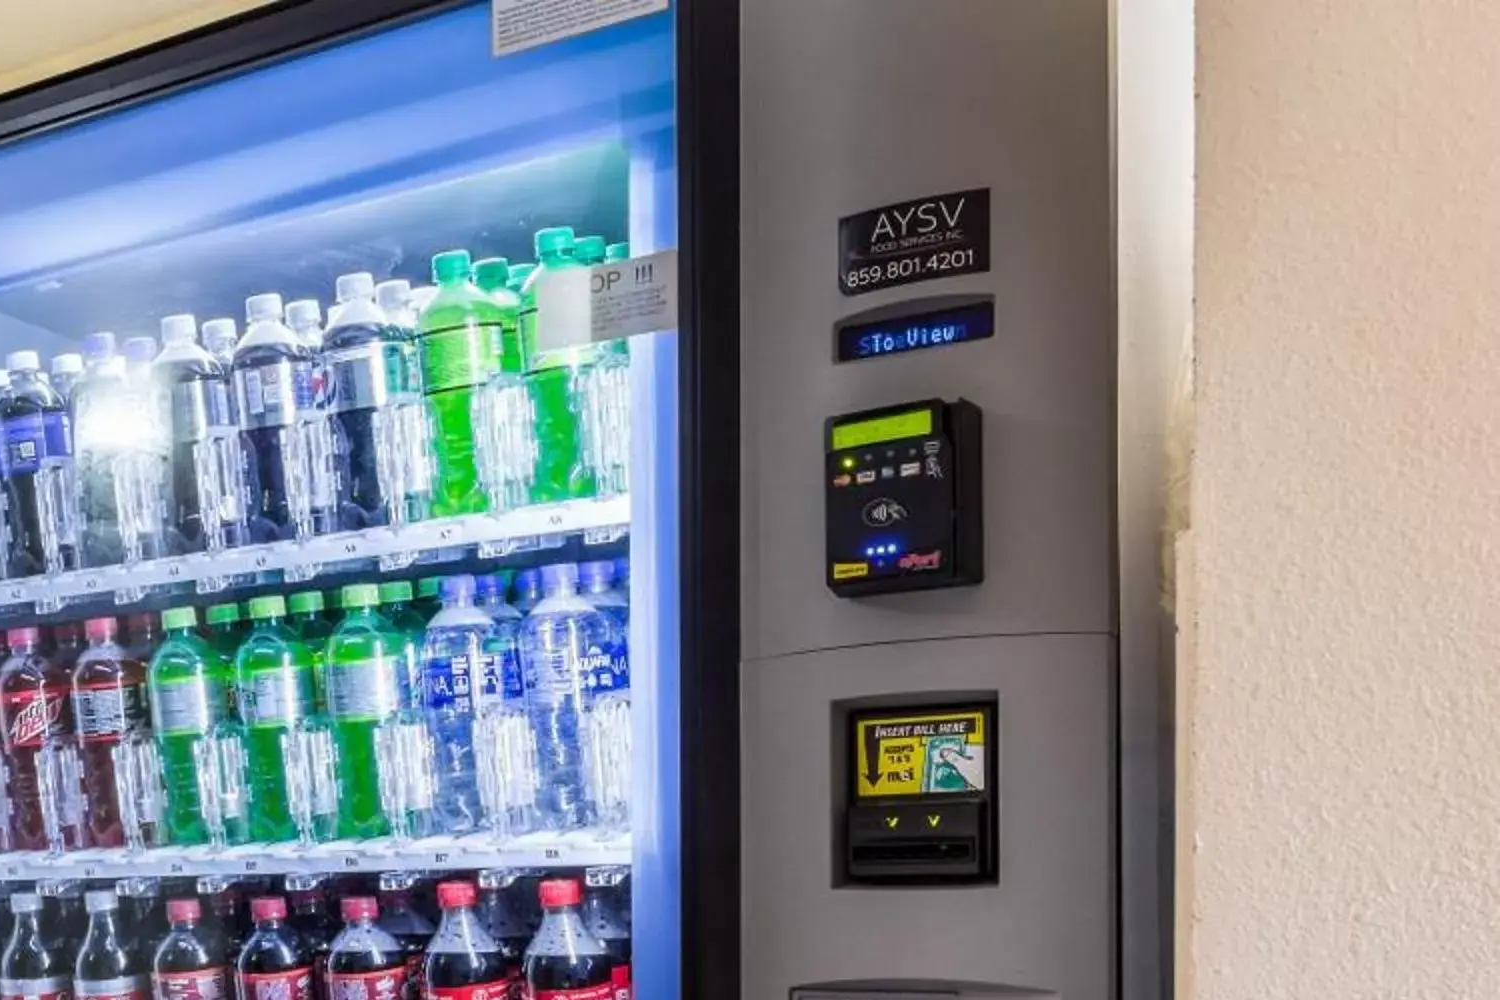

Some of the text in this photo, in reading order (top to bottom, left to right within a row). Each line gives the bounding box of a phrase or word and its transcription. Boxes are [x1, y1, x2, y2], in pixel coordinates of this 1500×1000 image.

[871, 197, 965, 243] AYSV
[847, 249, 974, 288] 859.801.4201
[871, 325, 956, 353] To View
[875, 724, 910, 740] INSERT
[940, 720, 968, 734] HERE
